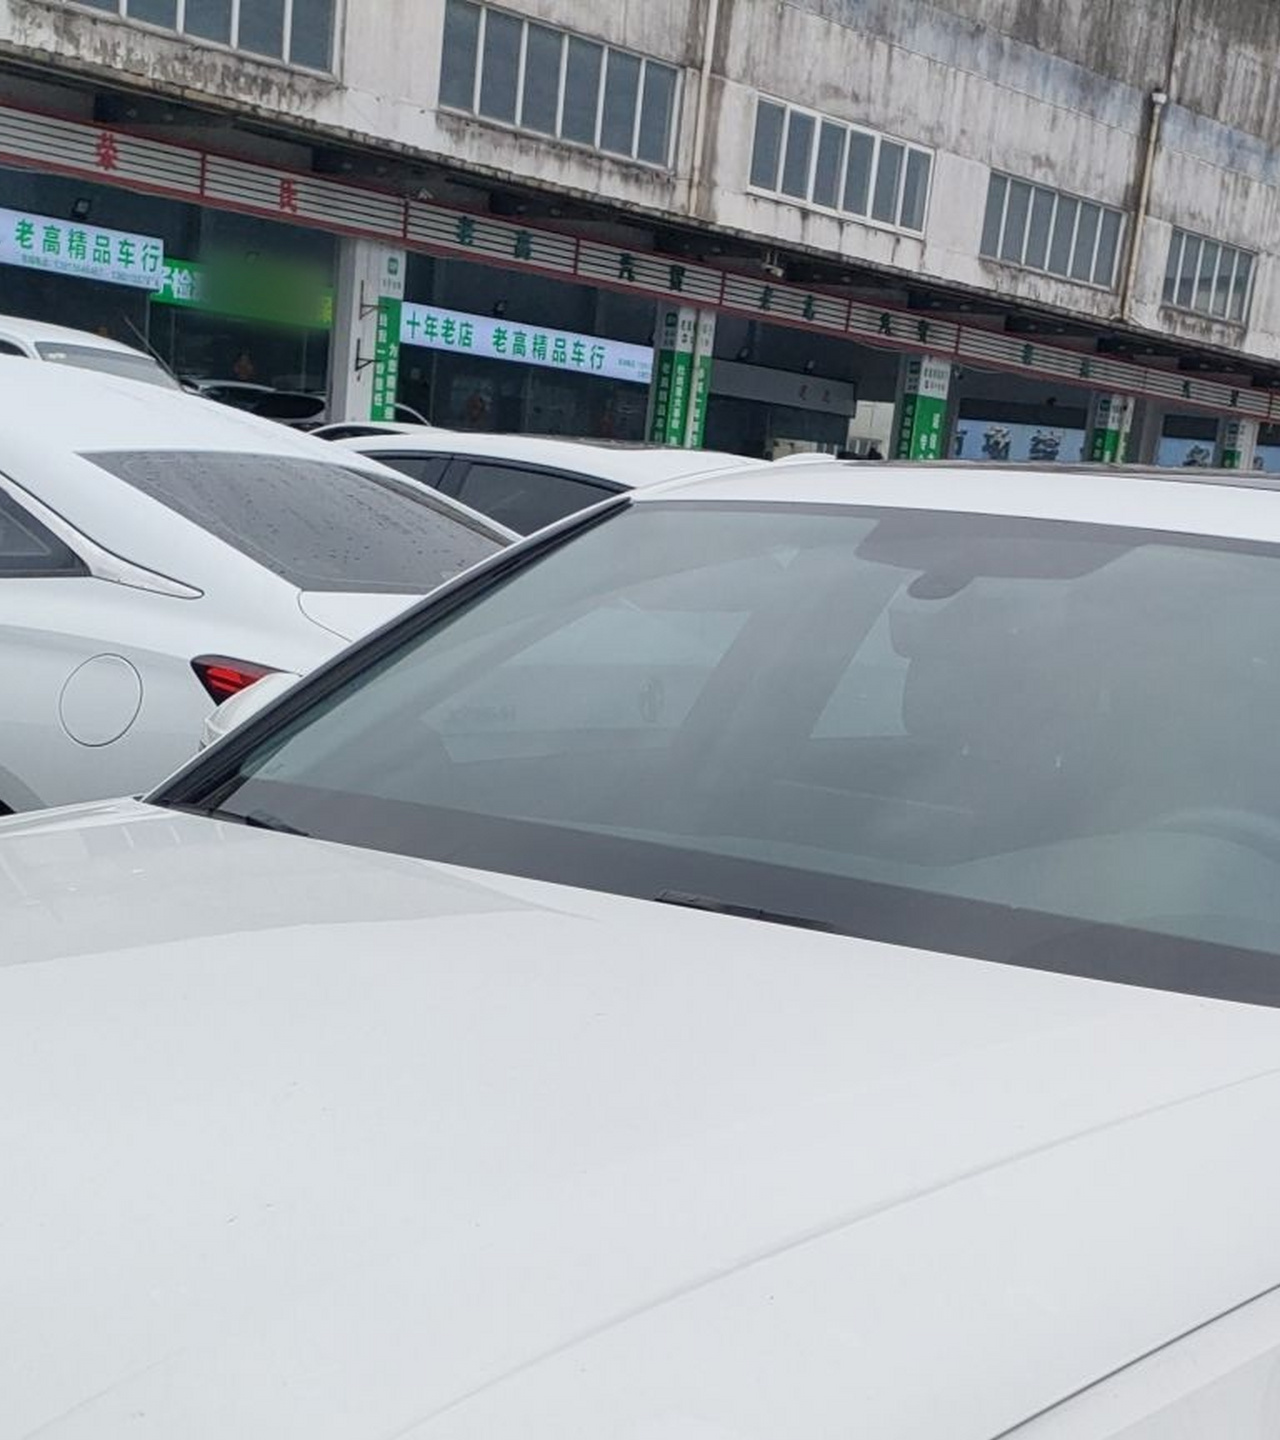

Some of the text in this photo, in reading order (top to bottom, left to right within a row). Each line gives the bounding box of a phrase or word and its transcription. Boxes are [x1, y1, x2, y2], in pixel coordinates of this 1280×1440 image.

[15, 219, 160, 273] 老高精品车行
[406, 312, 474, 348] 十年老店
[493, 327, 606, 370] 老高精品车行
